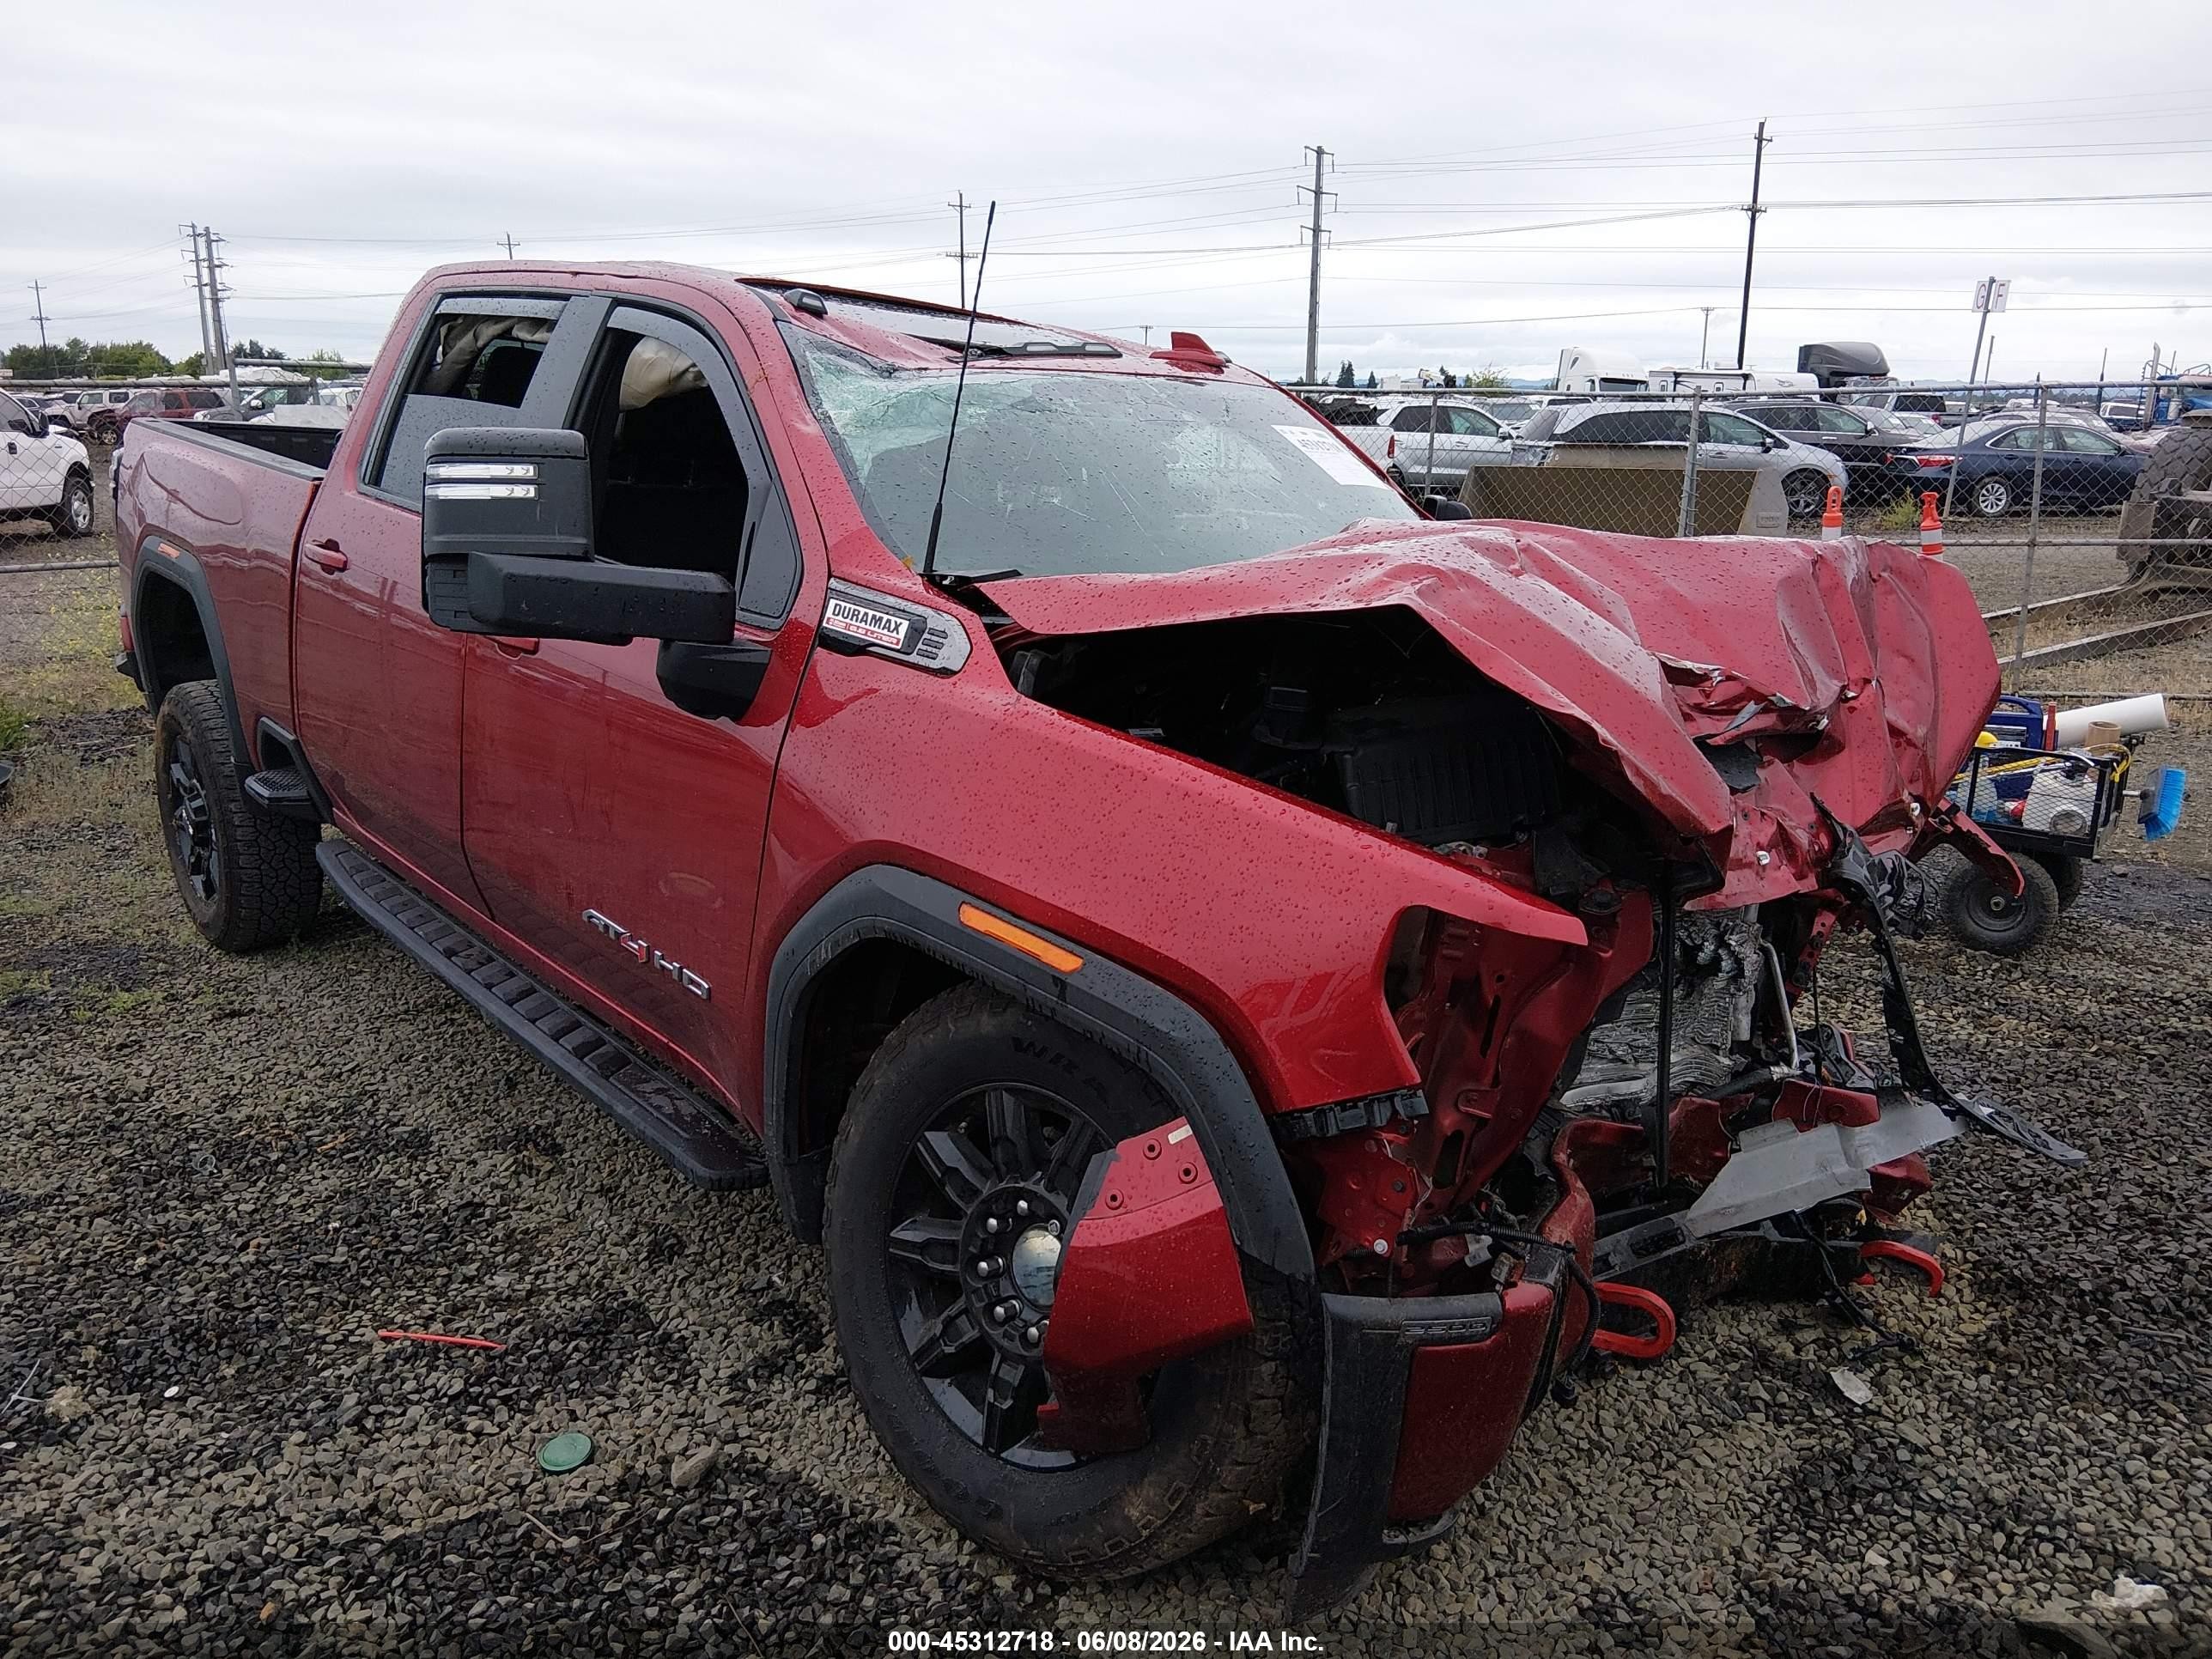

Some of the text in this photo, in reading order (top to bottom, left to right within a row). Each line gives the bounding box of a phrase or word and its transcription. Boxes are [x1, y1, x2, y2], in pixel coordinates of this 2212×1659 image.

[1975, 283, 1988, 310] G
[1995, 283, 2007, 310] F
[831, 603, 903, 635] DURAMAX
[581, 908, 712, 1001] AT4 HD
